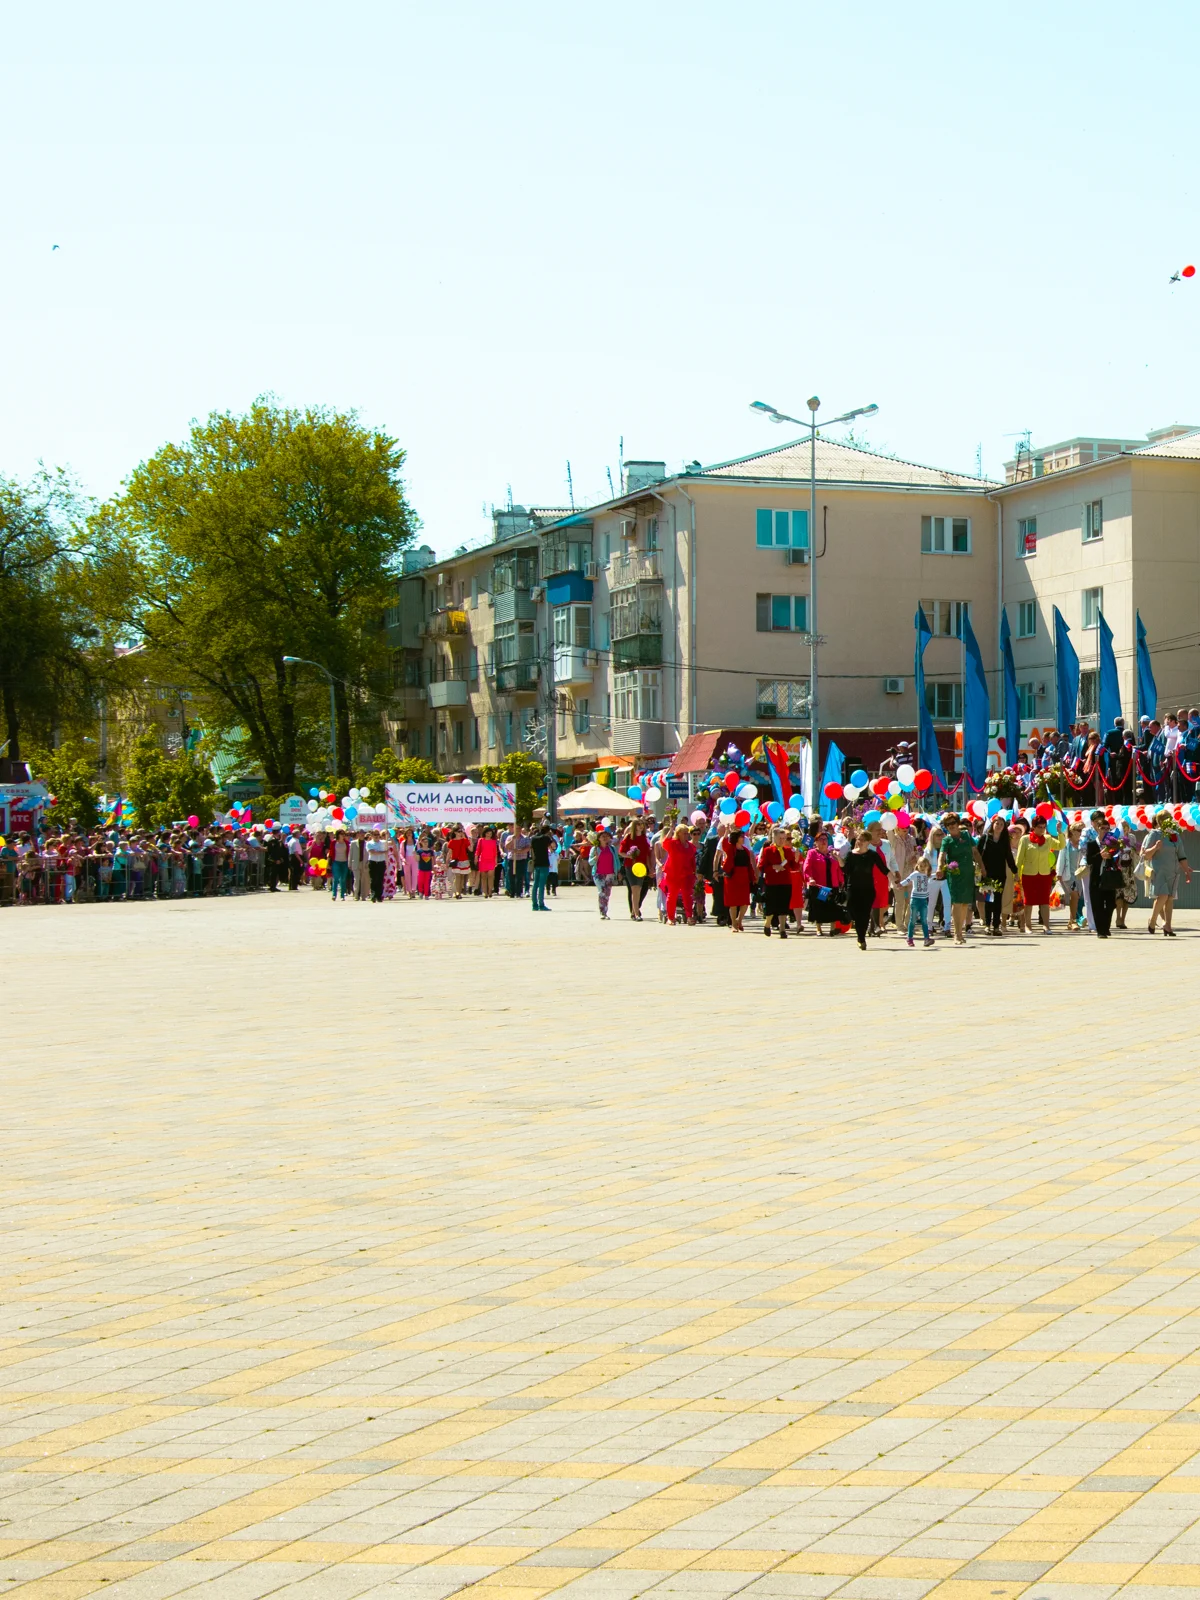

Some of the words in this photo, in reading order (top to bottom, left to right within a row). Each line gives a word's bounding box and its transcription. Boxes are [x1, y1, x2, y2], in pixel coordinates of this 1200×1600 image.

[407, 792, 440, 804] СМИ
[444, 793, 493, 804] Анапы
[10, 814, 29, 822] МТС
